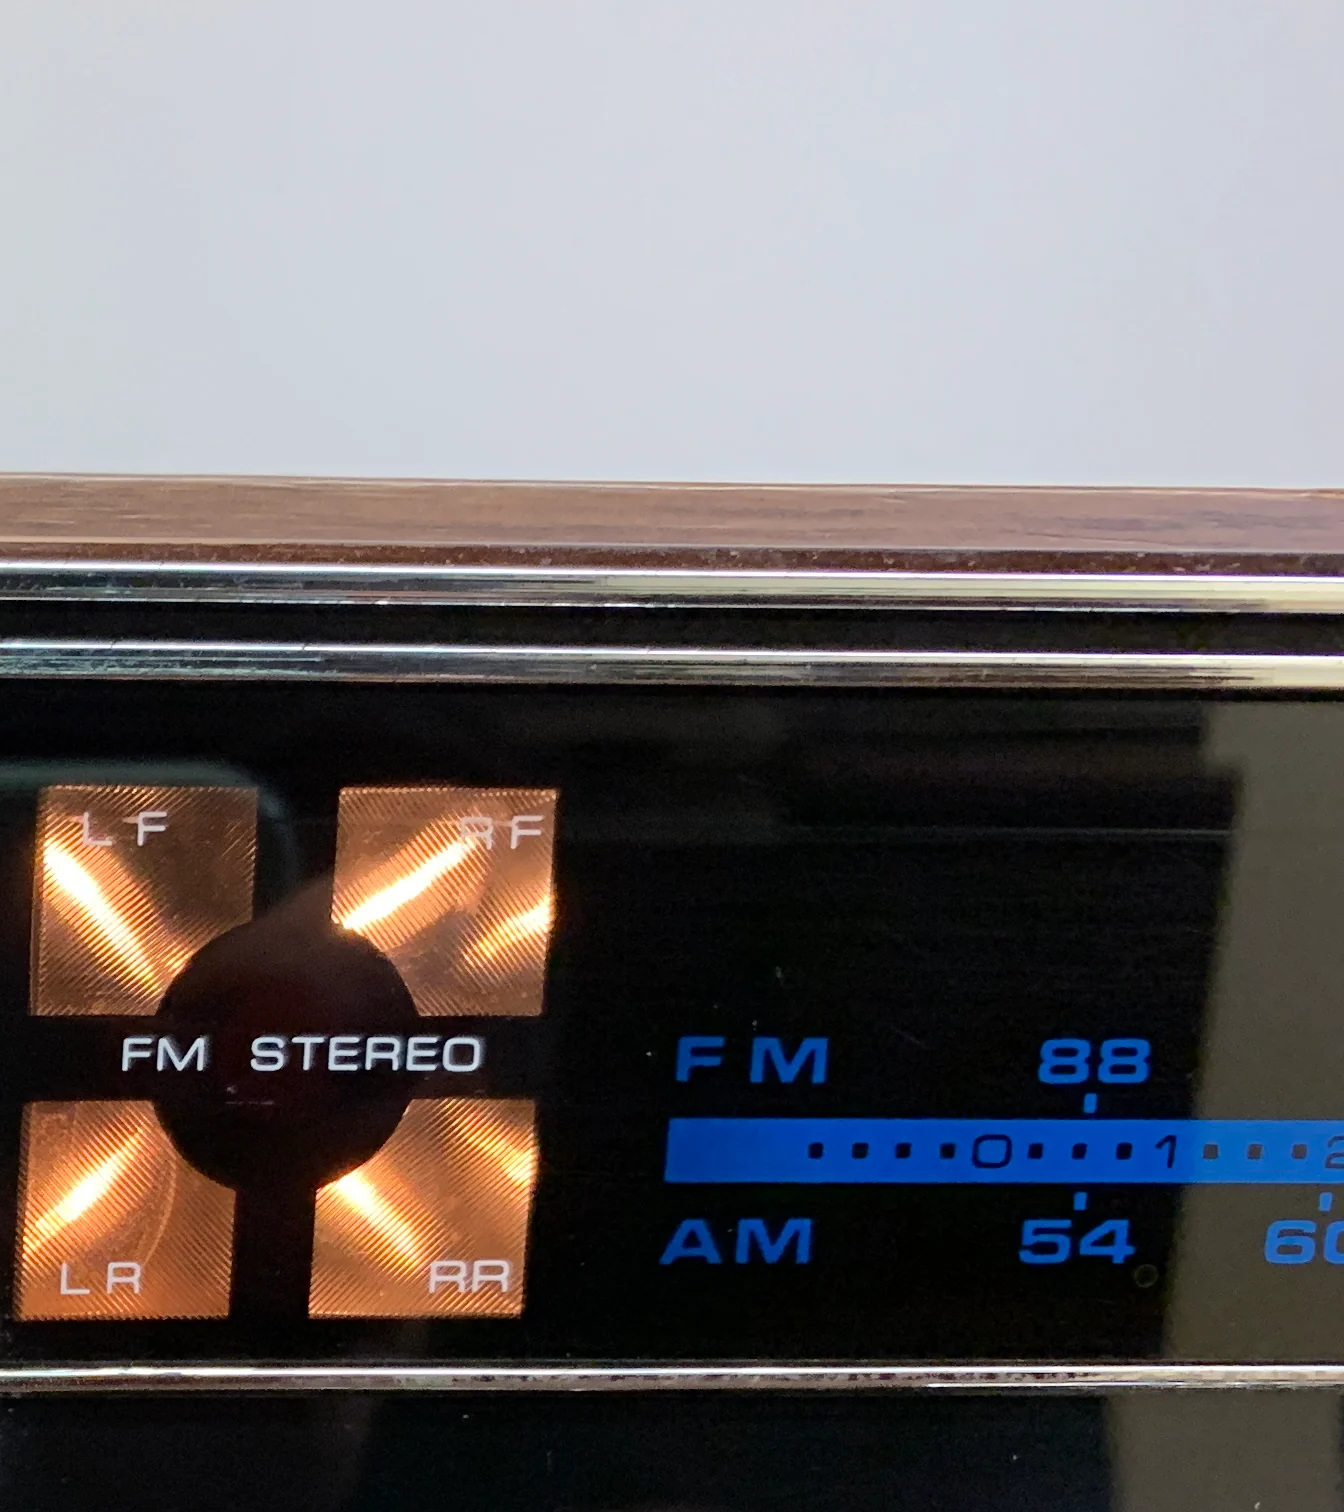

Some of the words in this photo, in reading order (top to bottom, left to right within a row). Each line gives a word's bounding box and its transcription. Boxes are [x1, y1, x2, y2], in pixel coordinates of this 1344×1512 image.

[120, 1035, 207, 1073] FM
[249, 1035, 484, 1074] STEREO
[675, 1036, 829, 1084] FM
[1037, 1037, 1152, 1085] 88
[1154, 1133, 1179, 1169] 1
[659, 1217, 813, 1265] AM
[1018, 1218, 1136, 1265] 54
[59, 1260, 142, 1295] LR
[427, 1258, 511, 1294] RR
